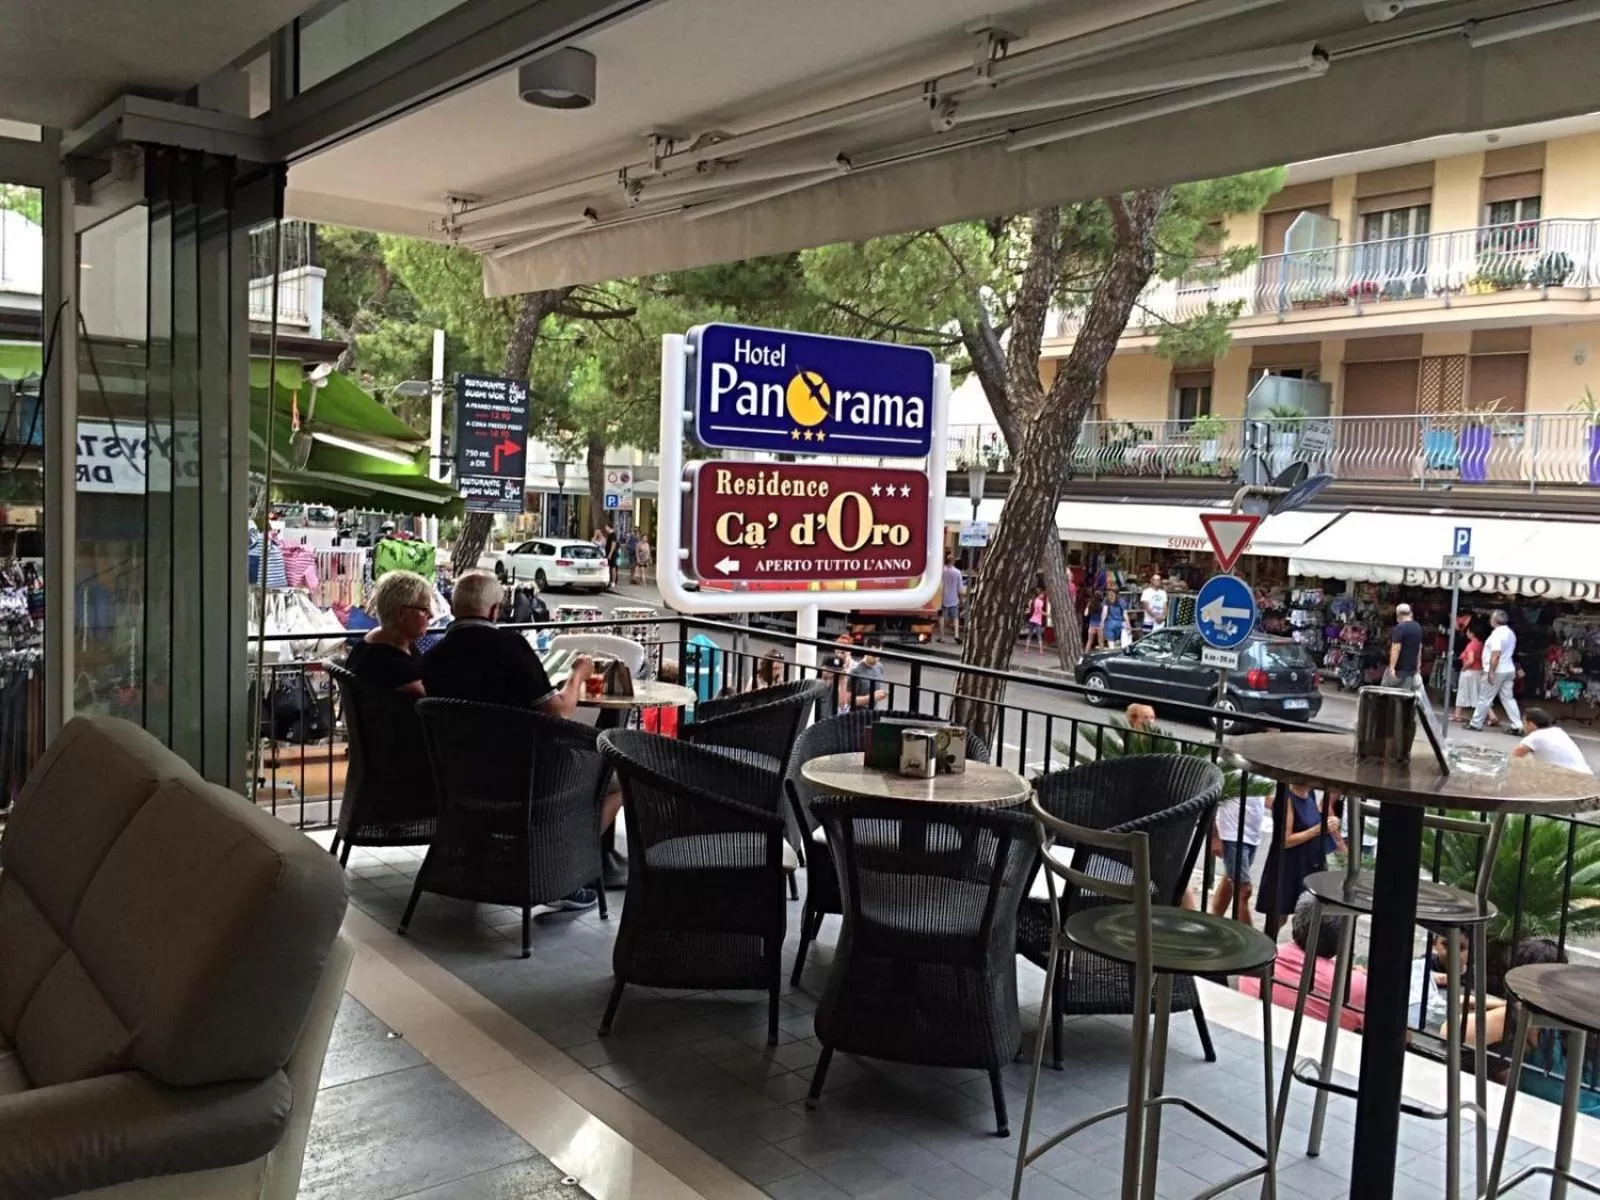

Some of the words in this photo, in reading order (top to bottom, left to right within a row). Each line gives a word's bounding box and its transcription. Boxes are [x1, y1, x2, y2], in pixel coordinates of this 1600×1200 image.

[735, 338, 786, 367] Hotel
[716, 469, 829, 498] Residence
[607, 495, 617, 507] P
[716, 511, 778, 549] Ca'
[790, 491, 911, 552] d'Oro
[1167, 538, 1206, 550] SUNNY
[1456, 529, 1469, 553] P
[754, 559, 812, 572] APERTO
[814, 559, 860, 572] TUTTO
[864, 558, 912, 571] L'ANNO
[1402, 568, 1551, 596] EMPORIO
